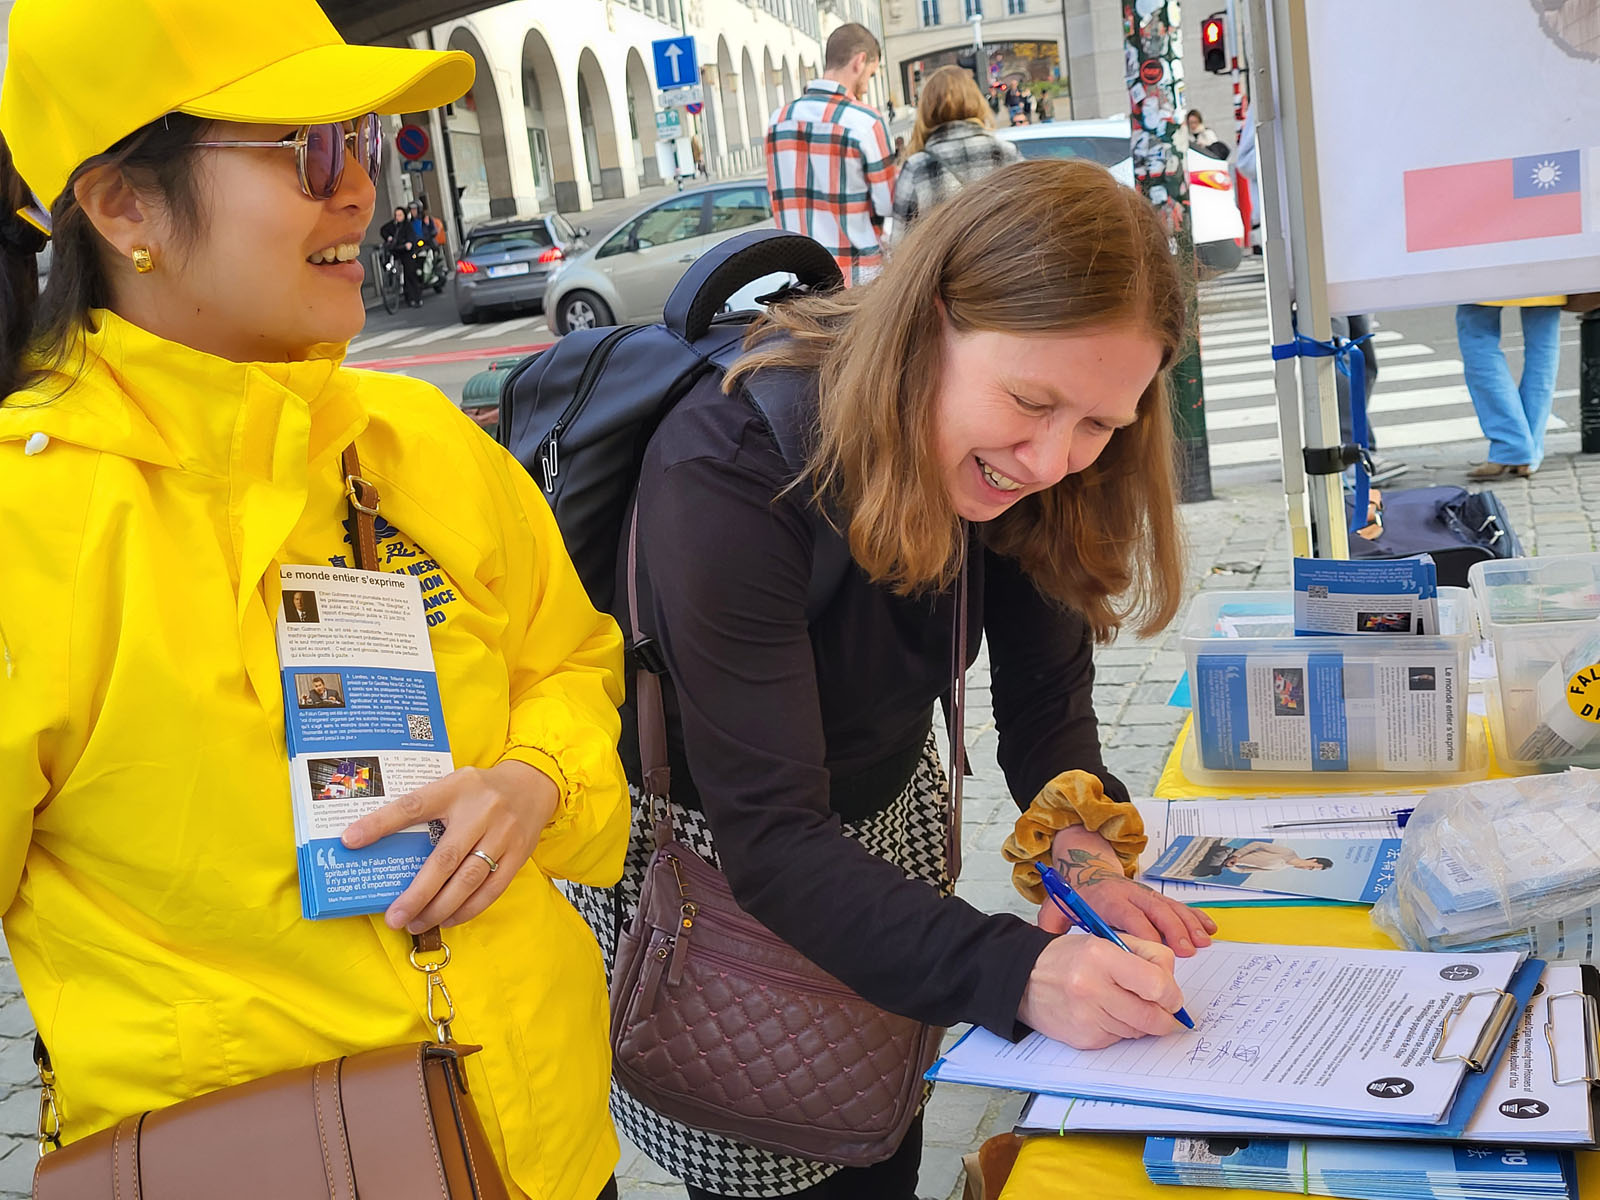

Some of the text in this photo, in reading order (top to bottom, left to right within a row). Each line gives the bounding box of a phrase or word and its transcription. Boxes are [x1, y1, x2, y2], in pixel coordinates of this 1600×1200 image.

[280, 569, 406, 589] Le monde entier s'exprime
[1443, 666, 1454, 761] Le monde entier s'exprime
[368, 858, 387, 866] Falun
[387, 856, 405, 865] Gong
[358, 867, 371, 875] plus
[372, 865, 401, 874] important
[347, 875, 360, 883] rien
[361, 874, 371, 882] qui
[386, 871, 416, 880] rapproche
[327, 885, 353, 893] courage
[1509, 1076, 1520, 1089] China
